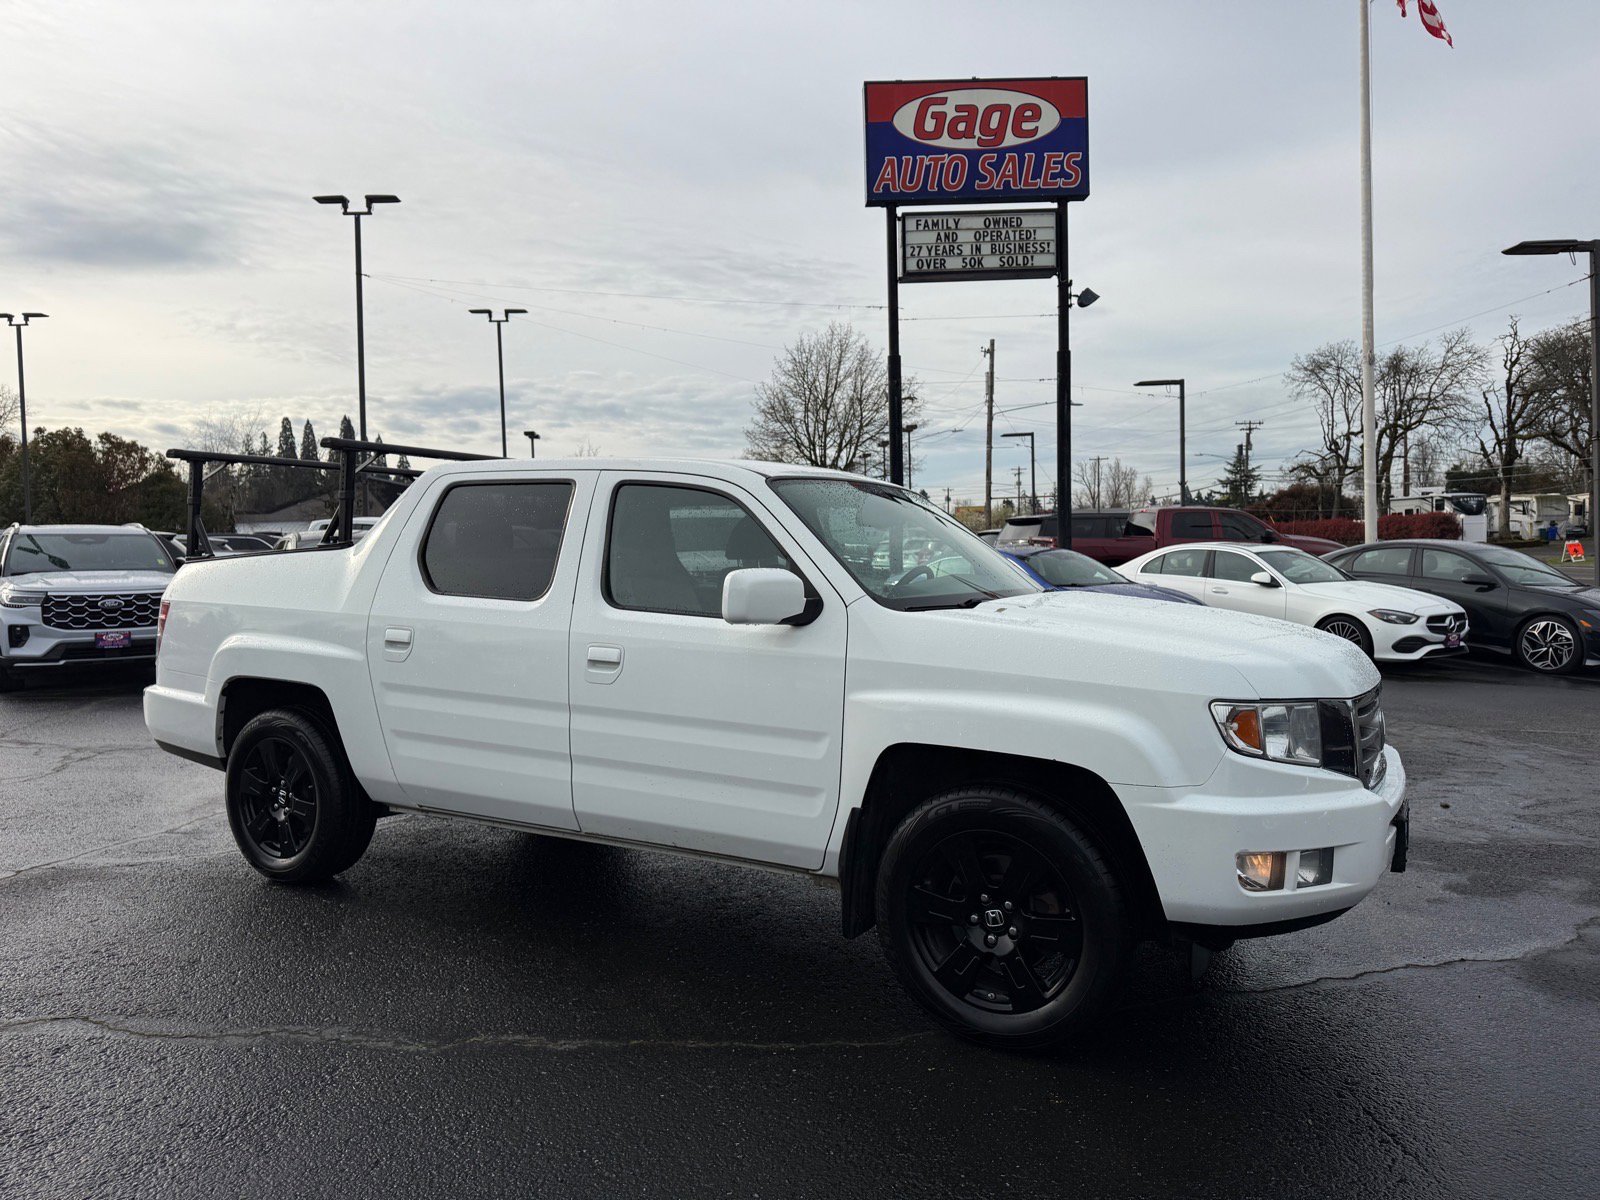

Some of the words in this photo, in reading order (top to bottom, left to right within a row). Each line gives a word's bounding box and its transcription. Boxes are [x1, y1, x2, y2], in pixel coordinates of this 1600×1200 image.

[913, 96, 1042, 147] Gage
[873, 153, 968, 193] AUTO
[975, 152, 1082, 191] SALES
[916, 218, 960, 230] FAMILY
[983, 217, 1023, 229] OWNED
[935, 231, 958, 243] AND
[973, 229, 1037, 242] OPERATED!
[910, 245, 922, 257] 27
[926, 244, 963, 256] YEARS
[970, 243, 982, 255] IN
[990, 242, 1051, 254] BUSINESS!
[916, 258, 946, 270] OVER
[962, 256, 984, 268] 50K
[999, 255, 1034, 267] SOLD!
